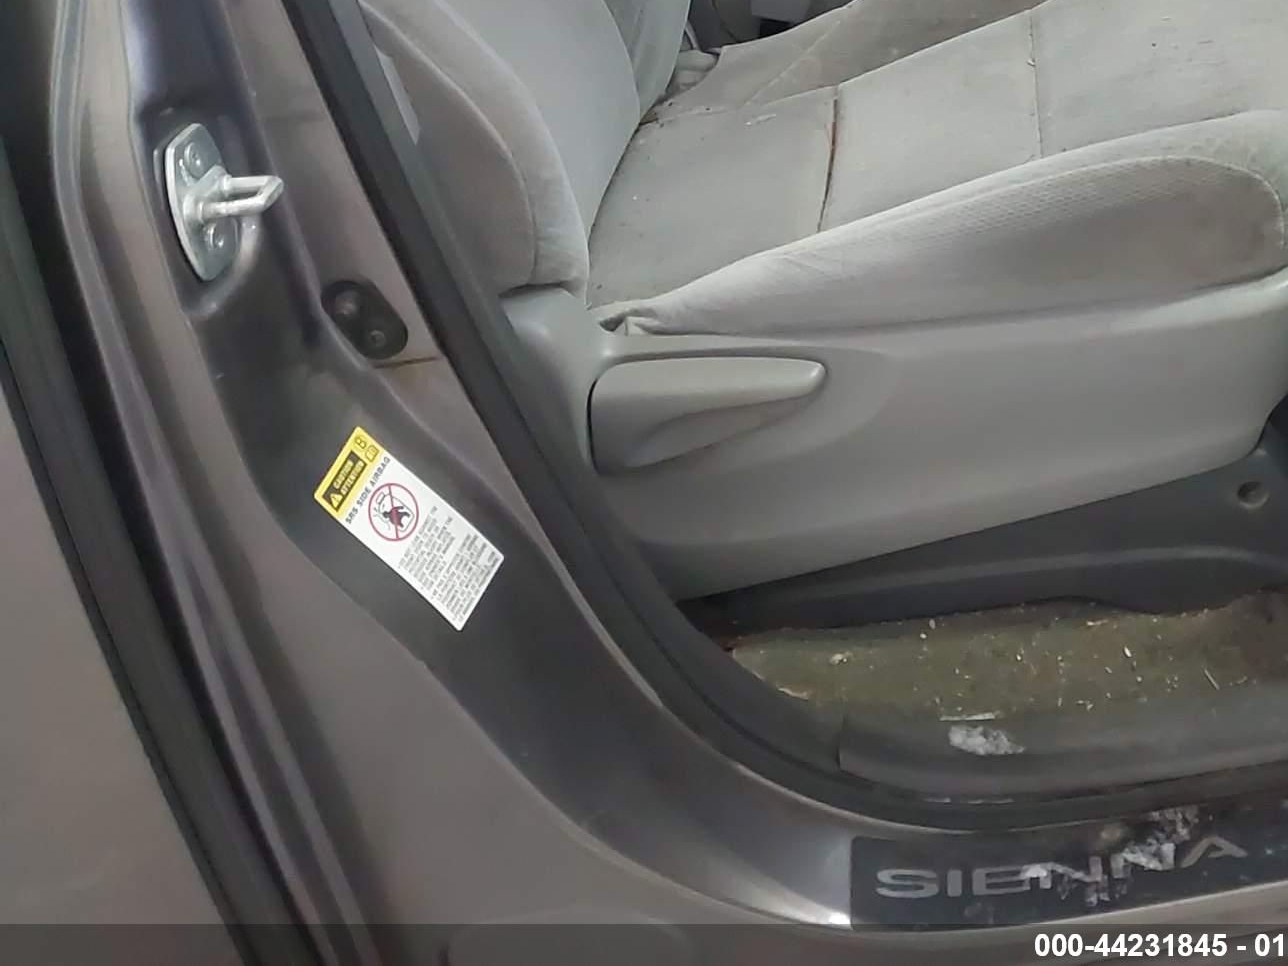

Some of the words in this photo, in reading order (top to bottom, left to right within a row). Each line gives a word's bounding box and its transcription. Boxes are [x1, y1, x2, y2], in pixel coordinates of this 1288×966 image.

[333, 459, 354, 489] CAUTION
[340, 460, 364, 495] ATTENTION
[345, 507, 358, 524] SRS
[356, 486, 371, 507] SIDE
[369, 456, 391, 487] AIRBAG
